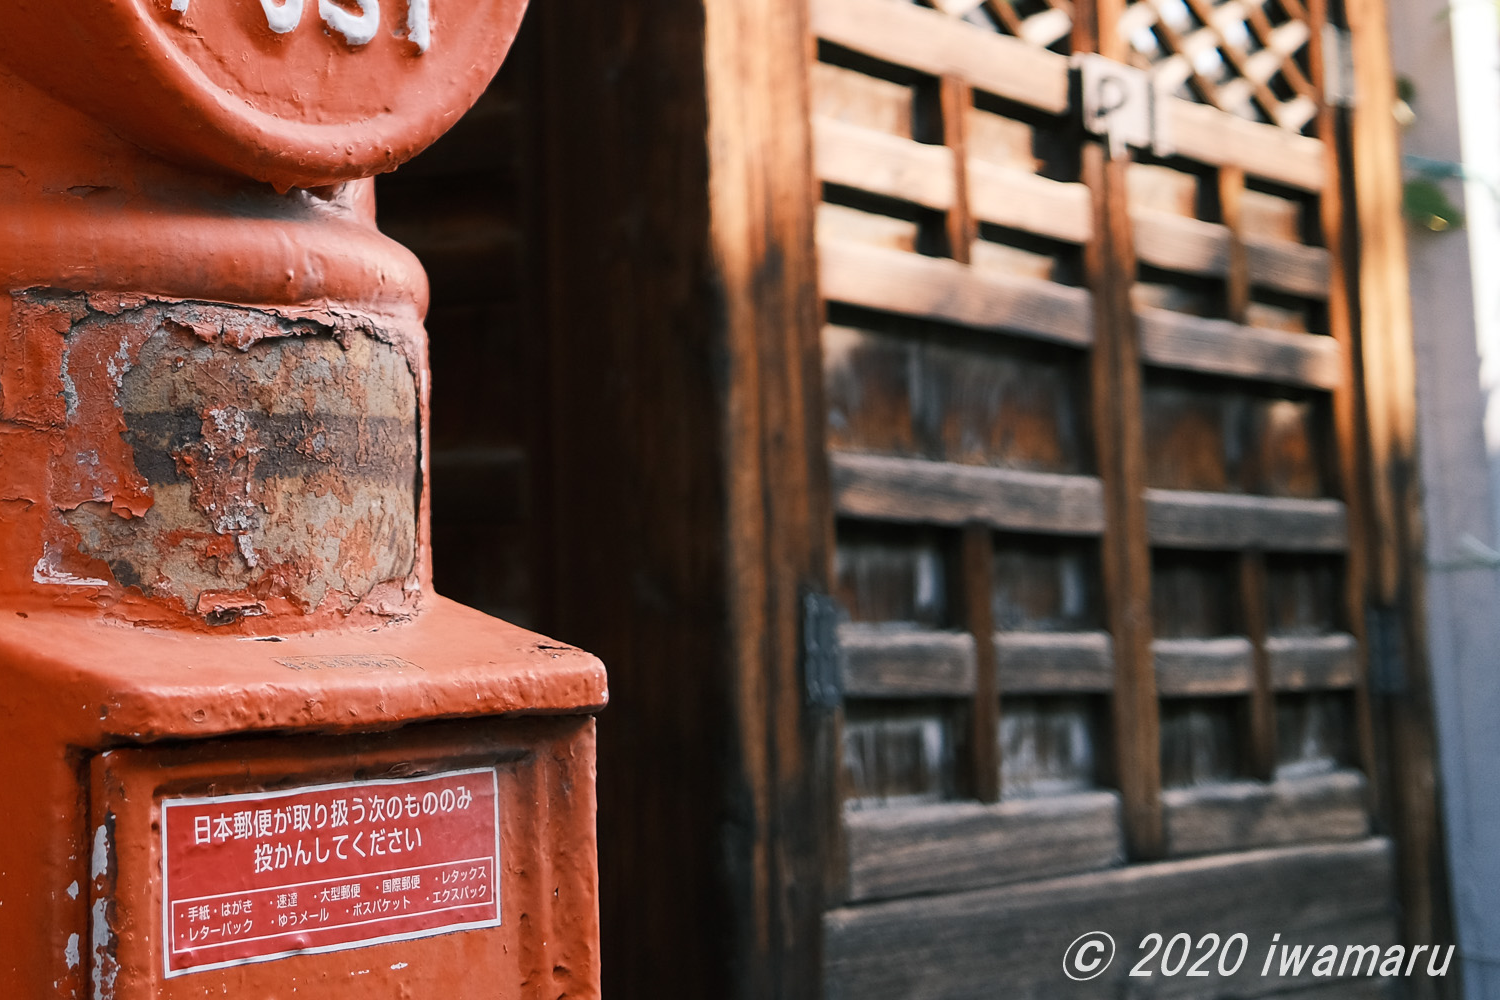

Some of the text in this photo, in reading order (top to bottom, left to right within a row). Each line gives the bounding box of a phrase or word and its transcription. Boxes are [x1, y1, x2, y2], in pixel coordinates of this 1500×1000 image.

[194, 786, 473, 845] 日本郵便が取り扱う次のもののみ
[254, 827, 423, 874] 投かんしてください
